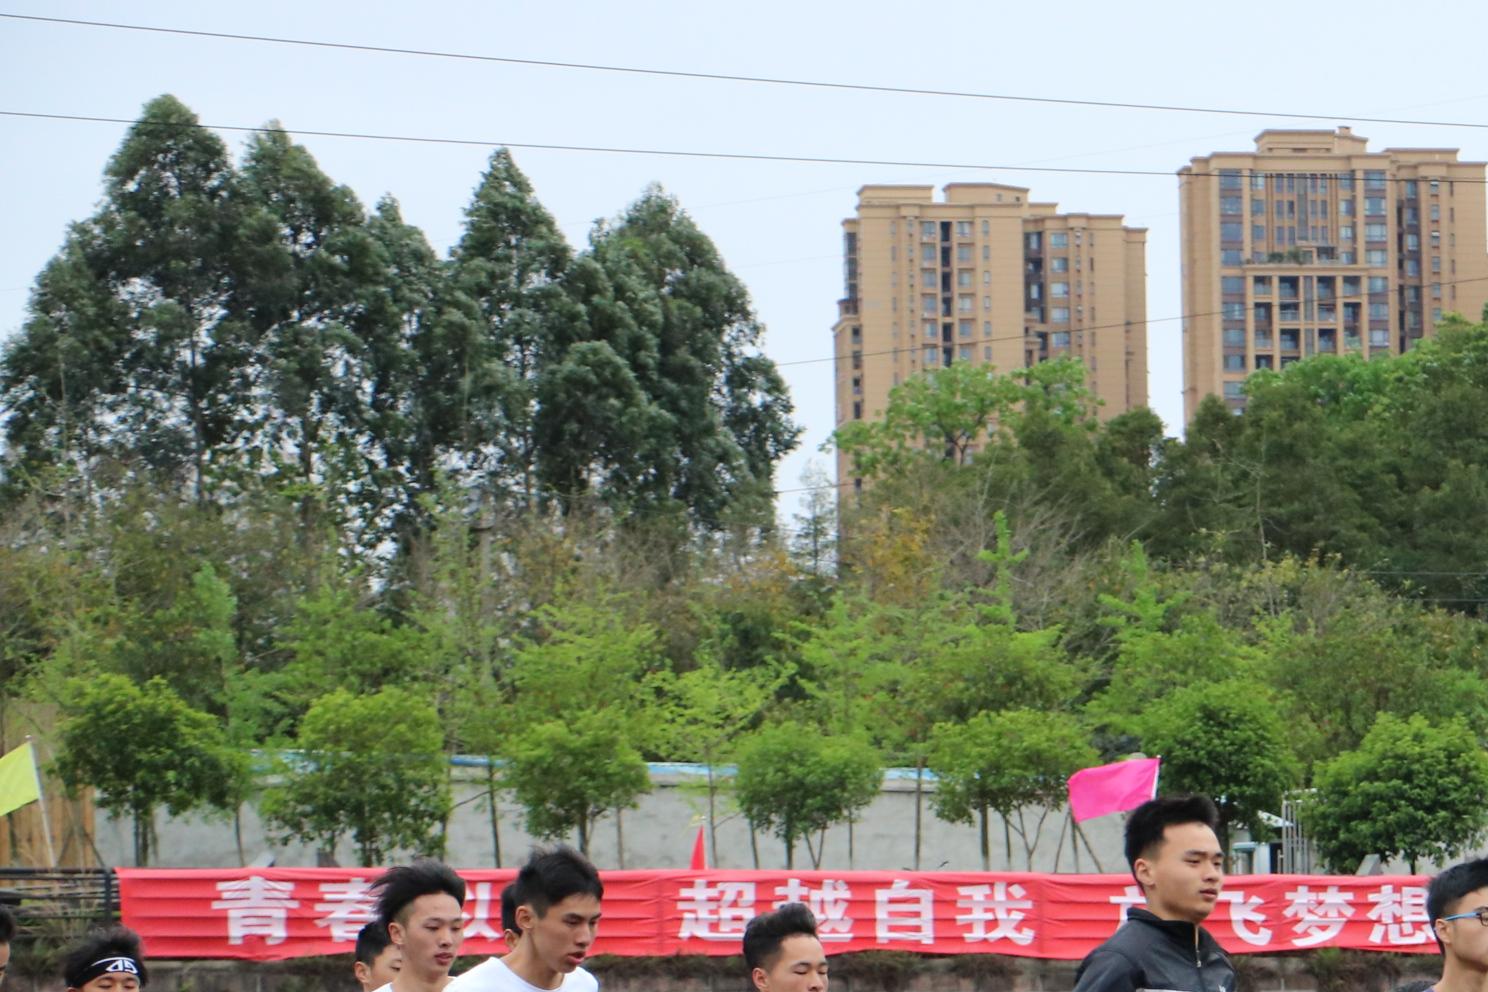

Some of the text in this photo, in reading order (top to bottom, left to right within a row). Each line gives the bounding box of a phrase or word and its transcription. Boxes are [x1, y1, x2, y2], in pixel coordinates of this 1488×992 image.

[676, 878, 1034, 945] 超越自我
[1109, 884, 1437, 947] 飞梦想
